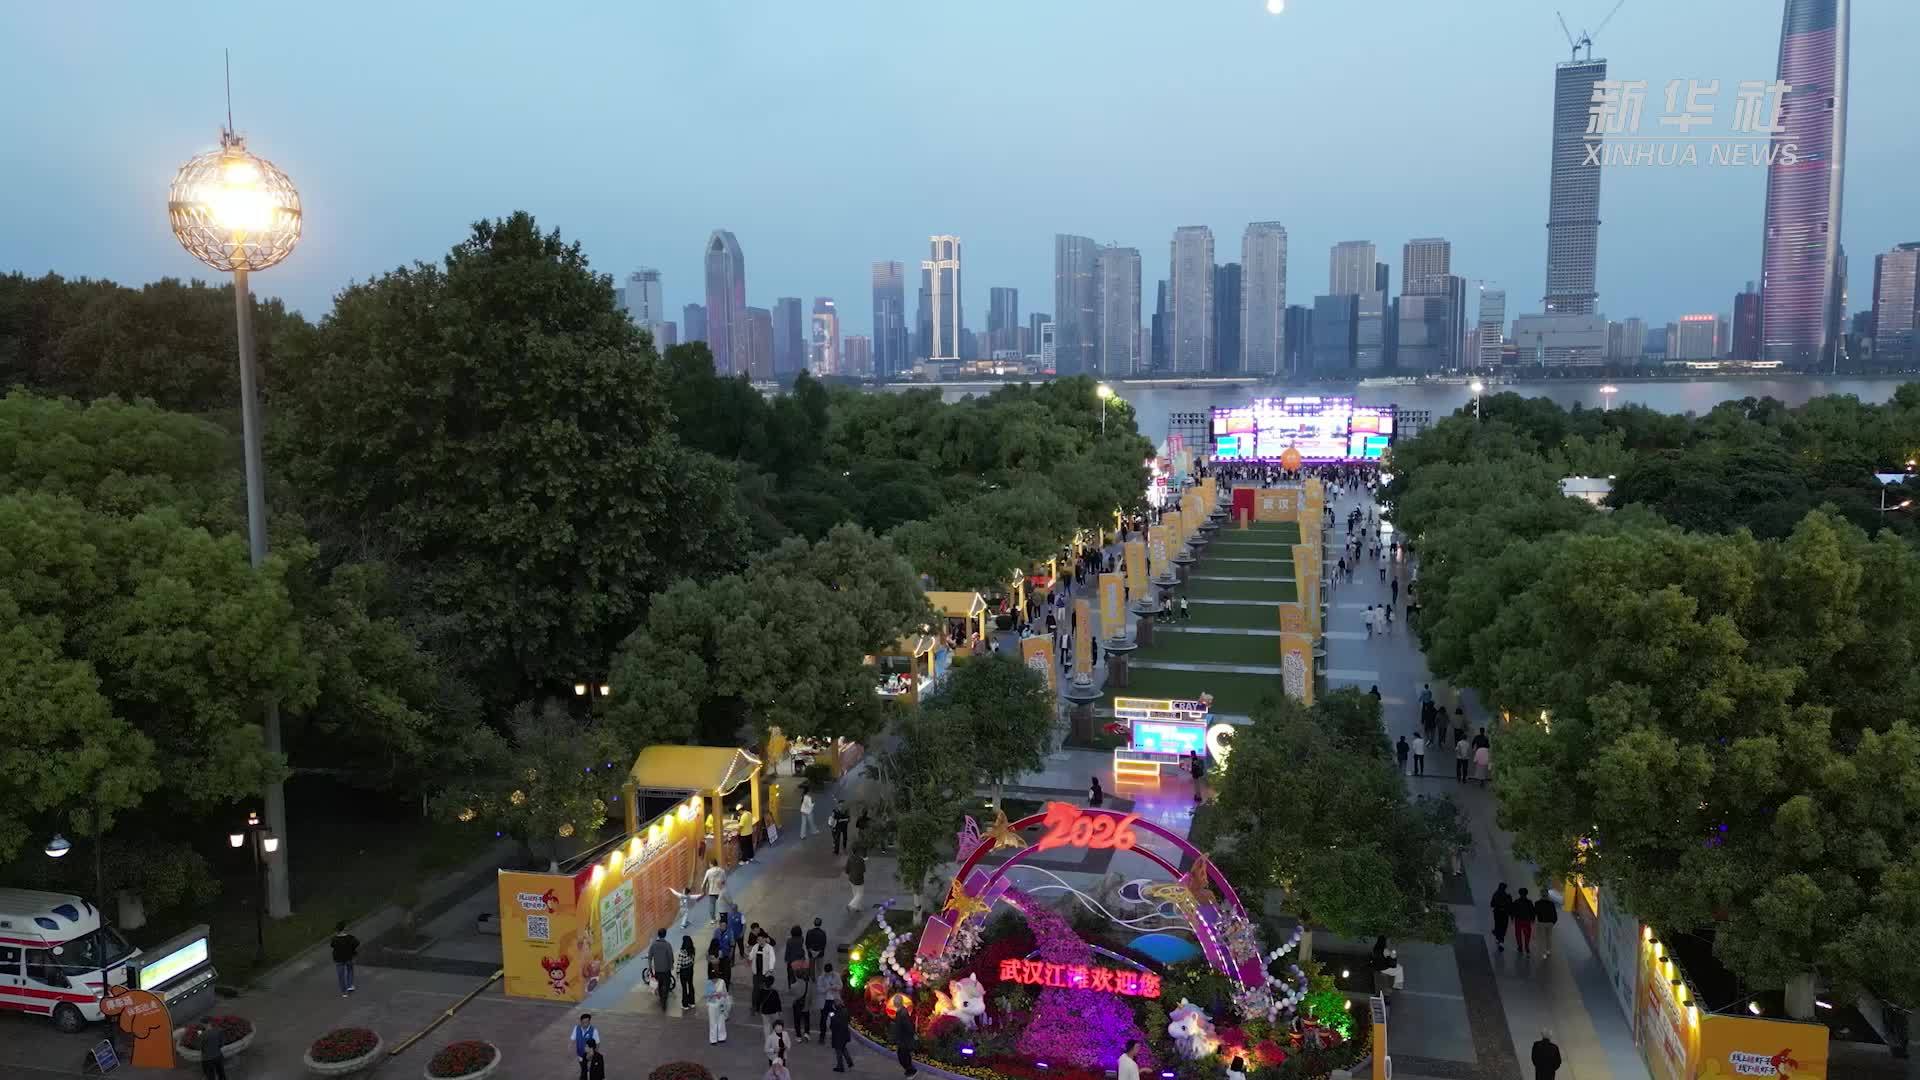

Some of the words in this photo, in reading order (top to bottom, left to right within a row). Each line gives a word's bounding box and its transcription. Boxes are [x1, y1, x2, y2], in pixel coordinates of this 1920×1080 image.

[1038, 802, 1140, 851] 2026
[1000, 957, 1161, 998] 武汉江滩欢迎您
